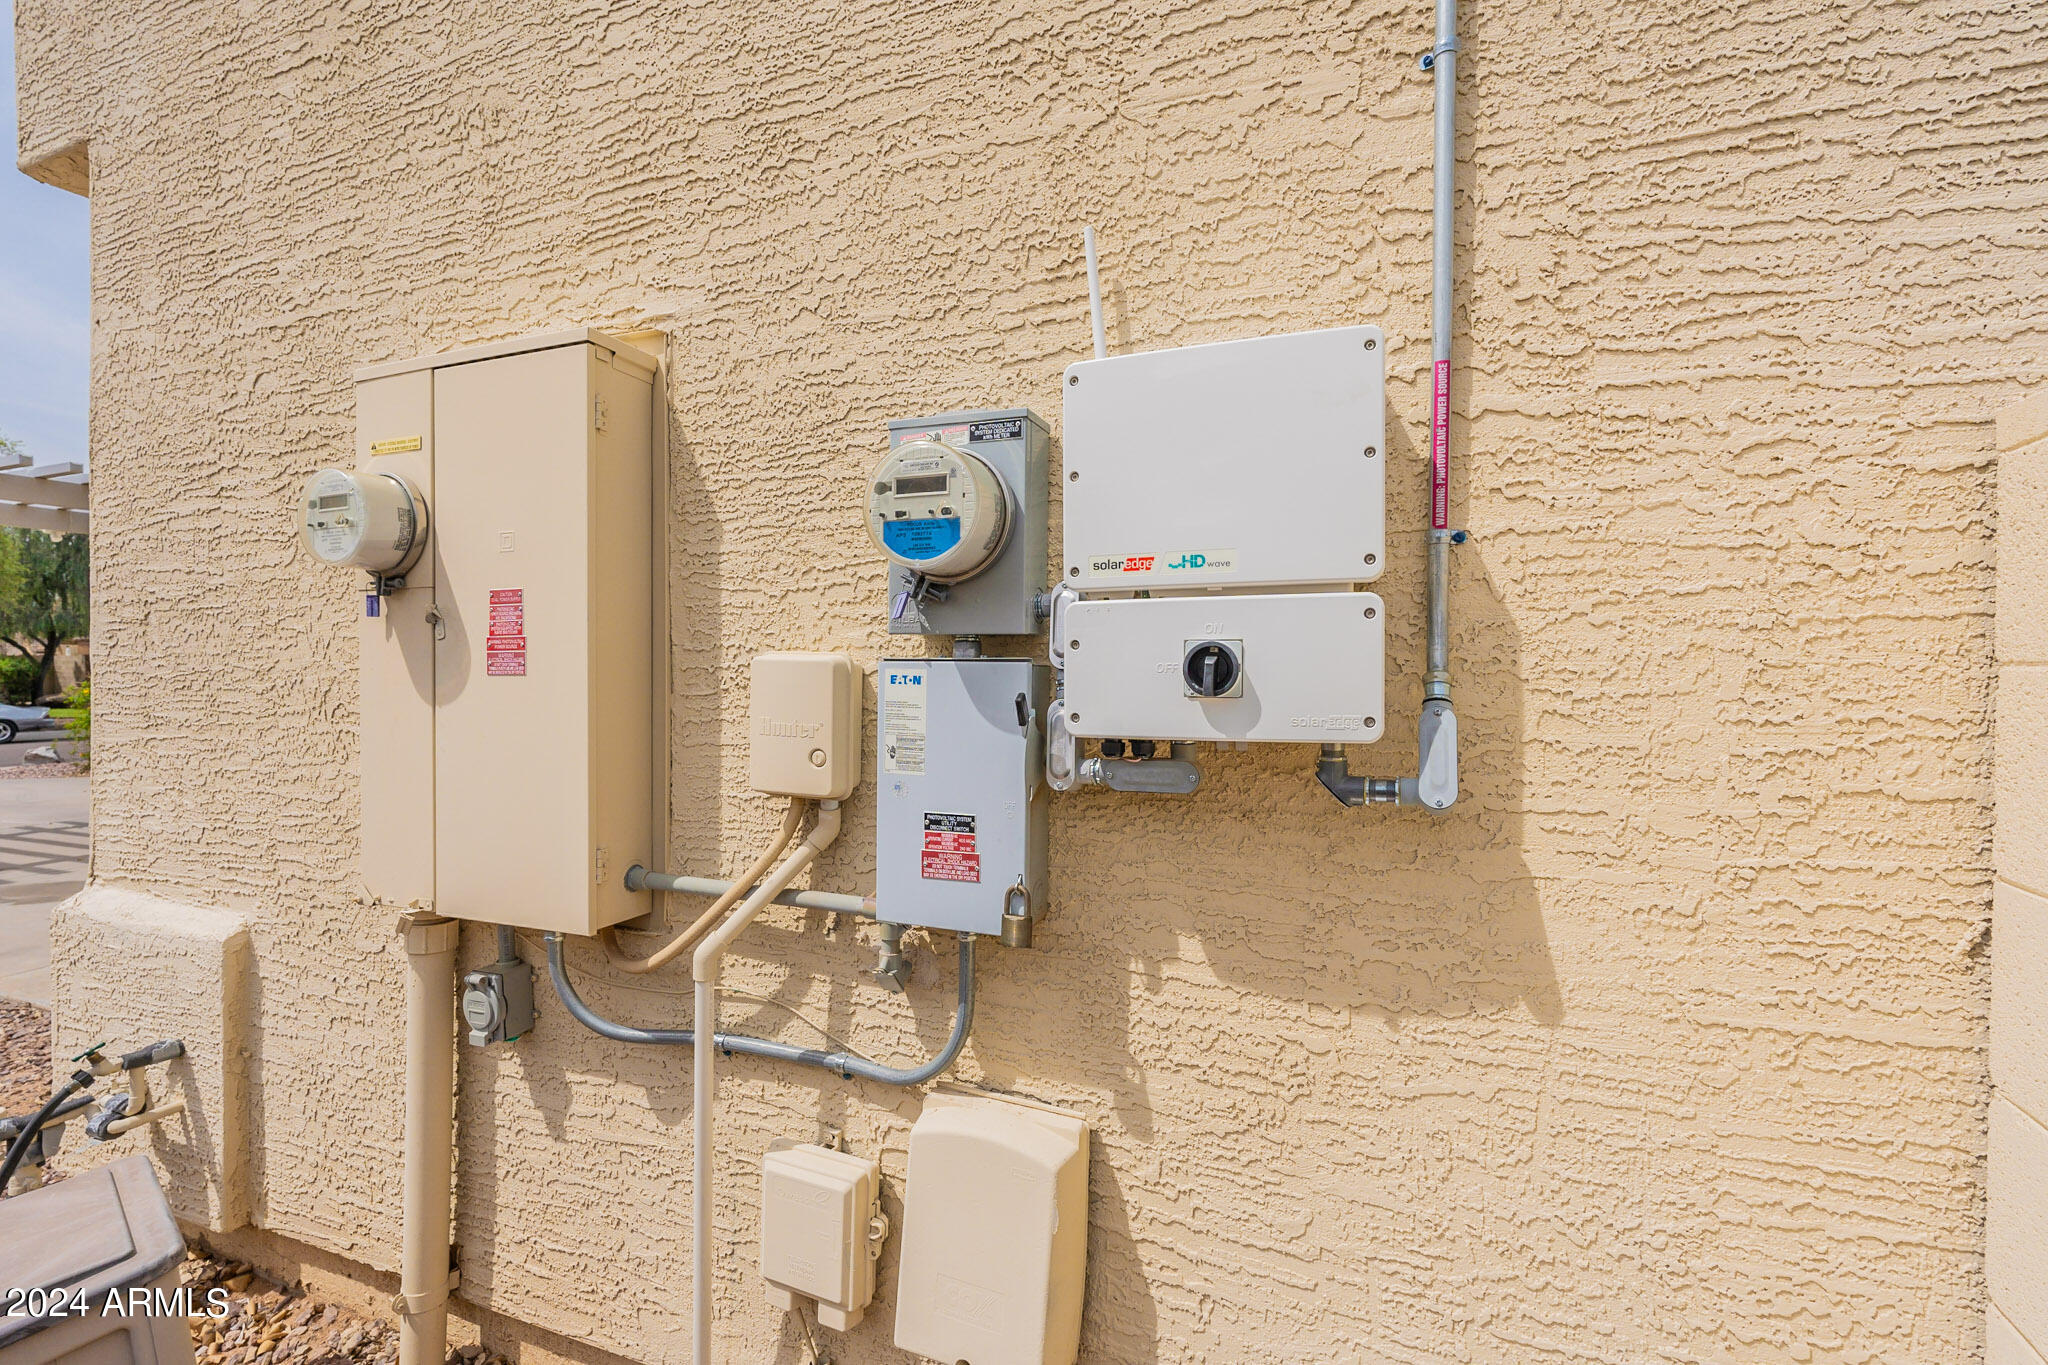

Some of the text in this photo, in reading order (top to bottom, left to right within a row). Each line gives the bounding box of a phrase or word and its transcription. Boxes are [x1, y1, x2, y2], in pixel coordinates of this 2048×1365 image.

[979, 422, 1015, 431] PHOTOVOLTAIC
[1435, 362, 1449, 527] WARNING: PHOTOVOLTAIC POWER SOURCE
[1093, 556, 1155, 571] solaredge
[1180, 554, 1231, 569] HD wave
[1204, 621, 1225, 635] ON
[1155, 662, 1180, 674] OFF
